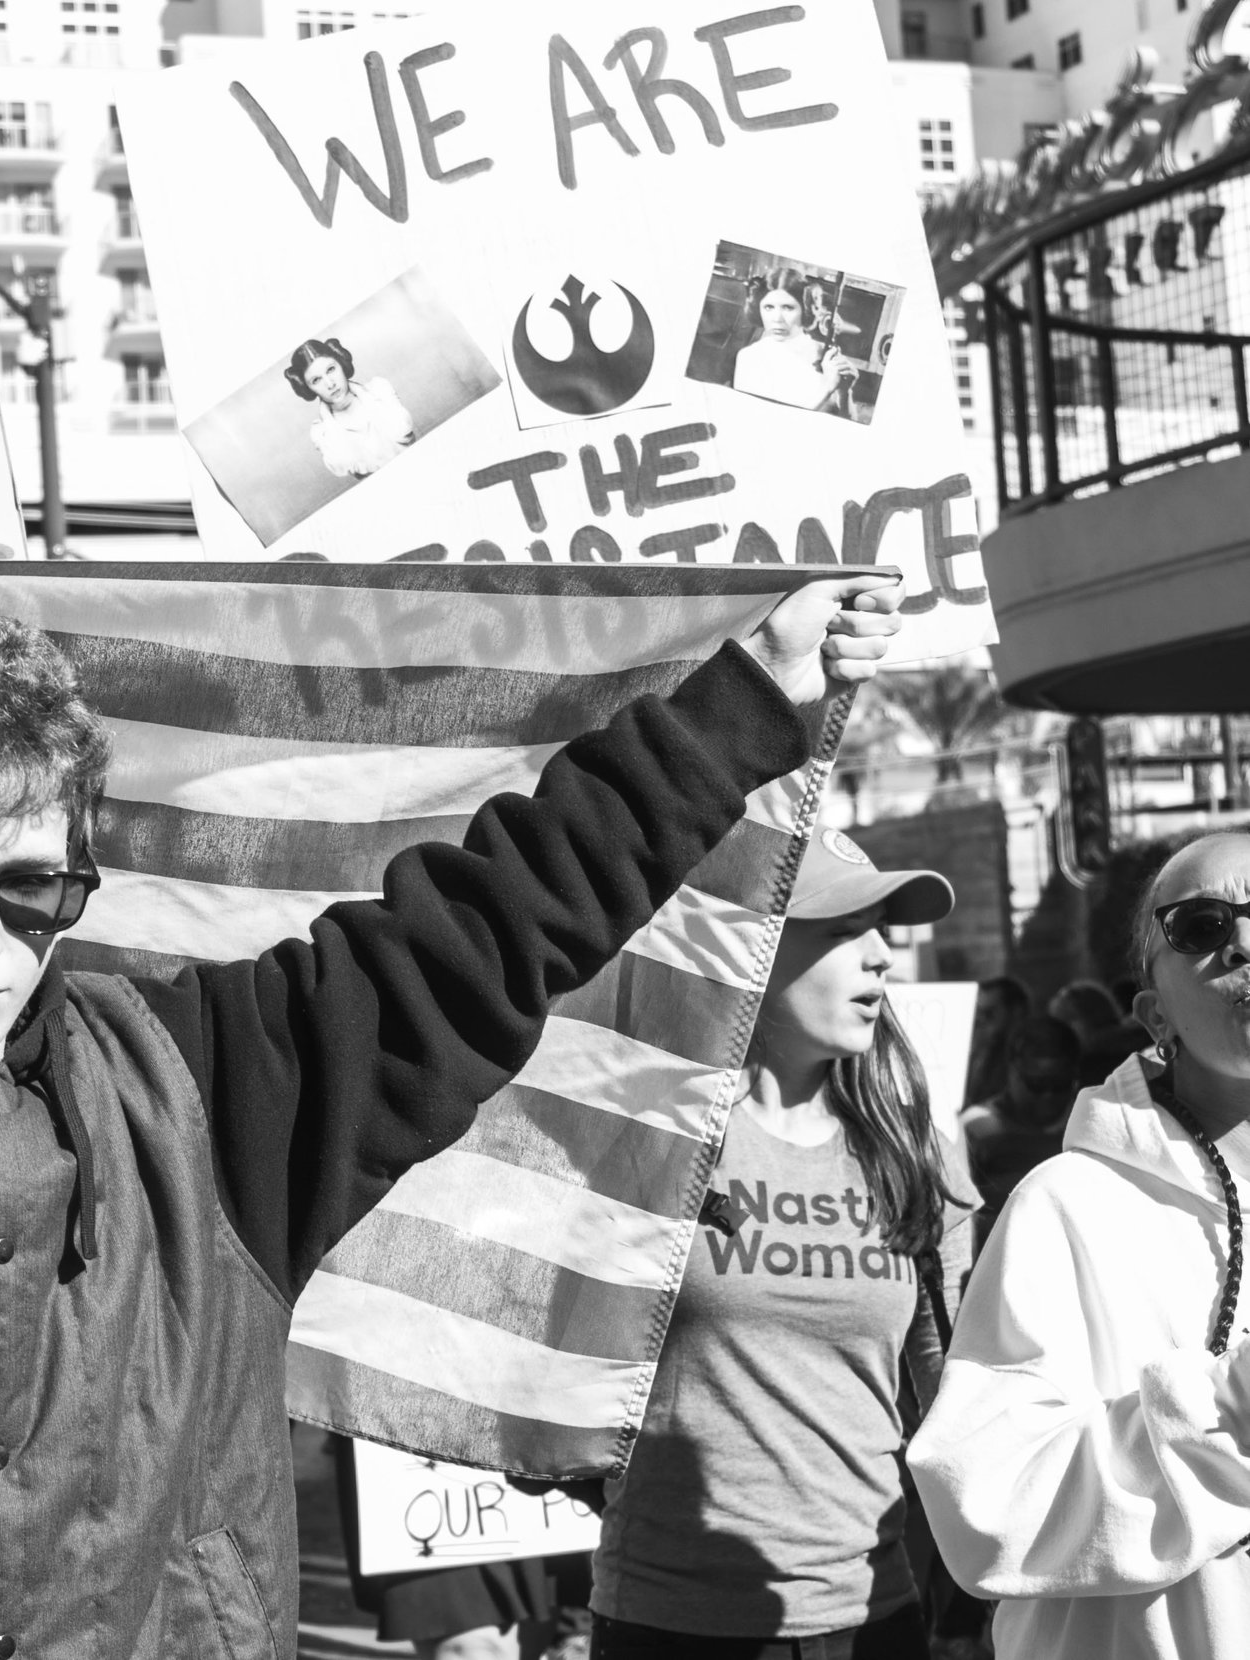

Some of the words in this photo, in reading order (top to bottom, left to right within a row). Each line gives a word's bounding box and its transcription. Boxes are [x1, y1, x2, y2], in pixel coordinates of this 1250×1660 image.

[229, 42, 495, 229] WE
[548, 5, 839, 191] ARE
[467, 422, 736, 533] THE
[728, 1179, 870, 1230] Nast
[405, 1481, 509, 1540] OUR
